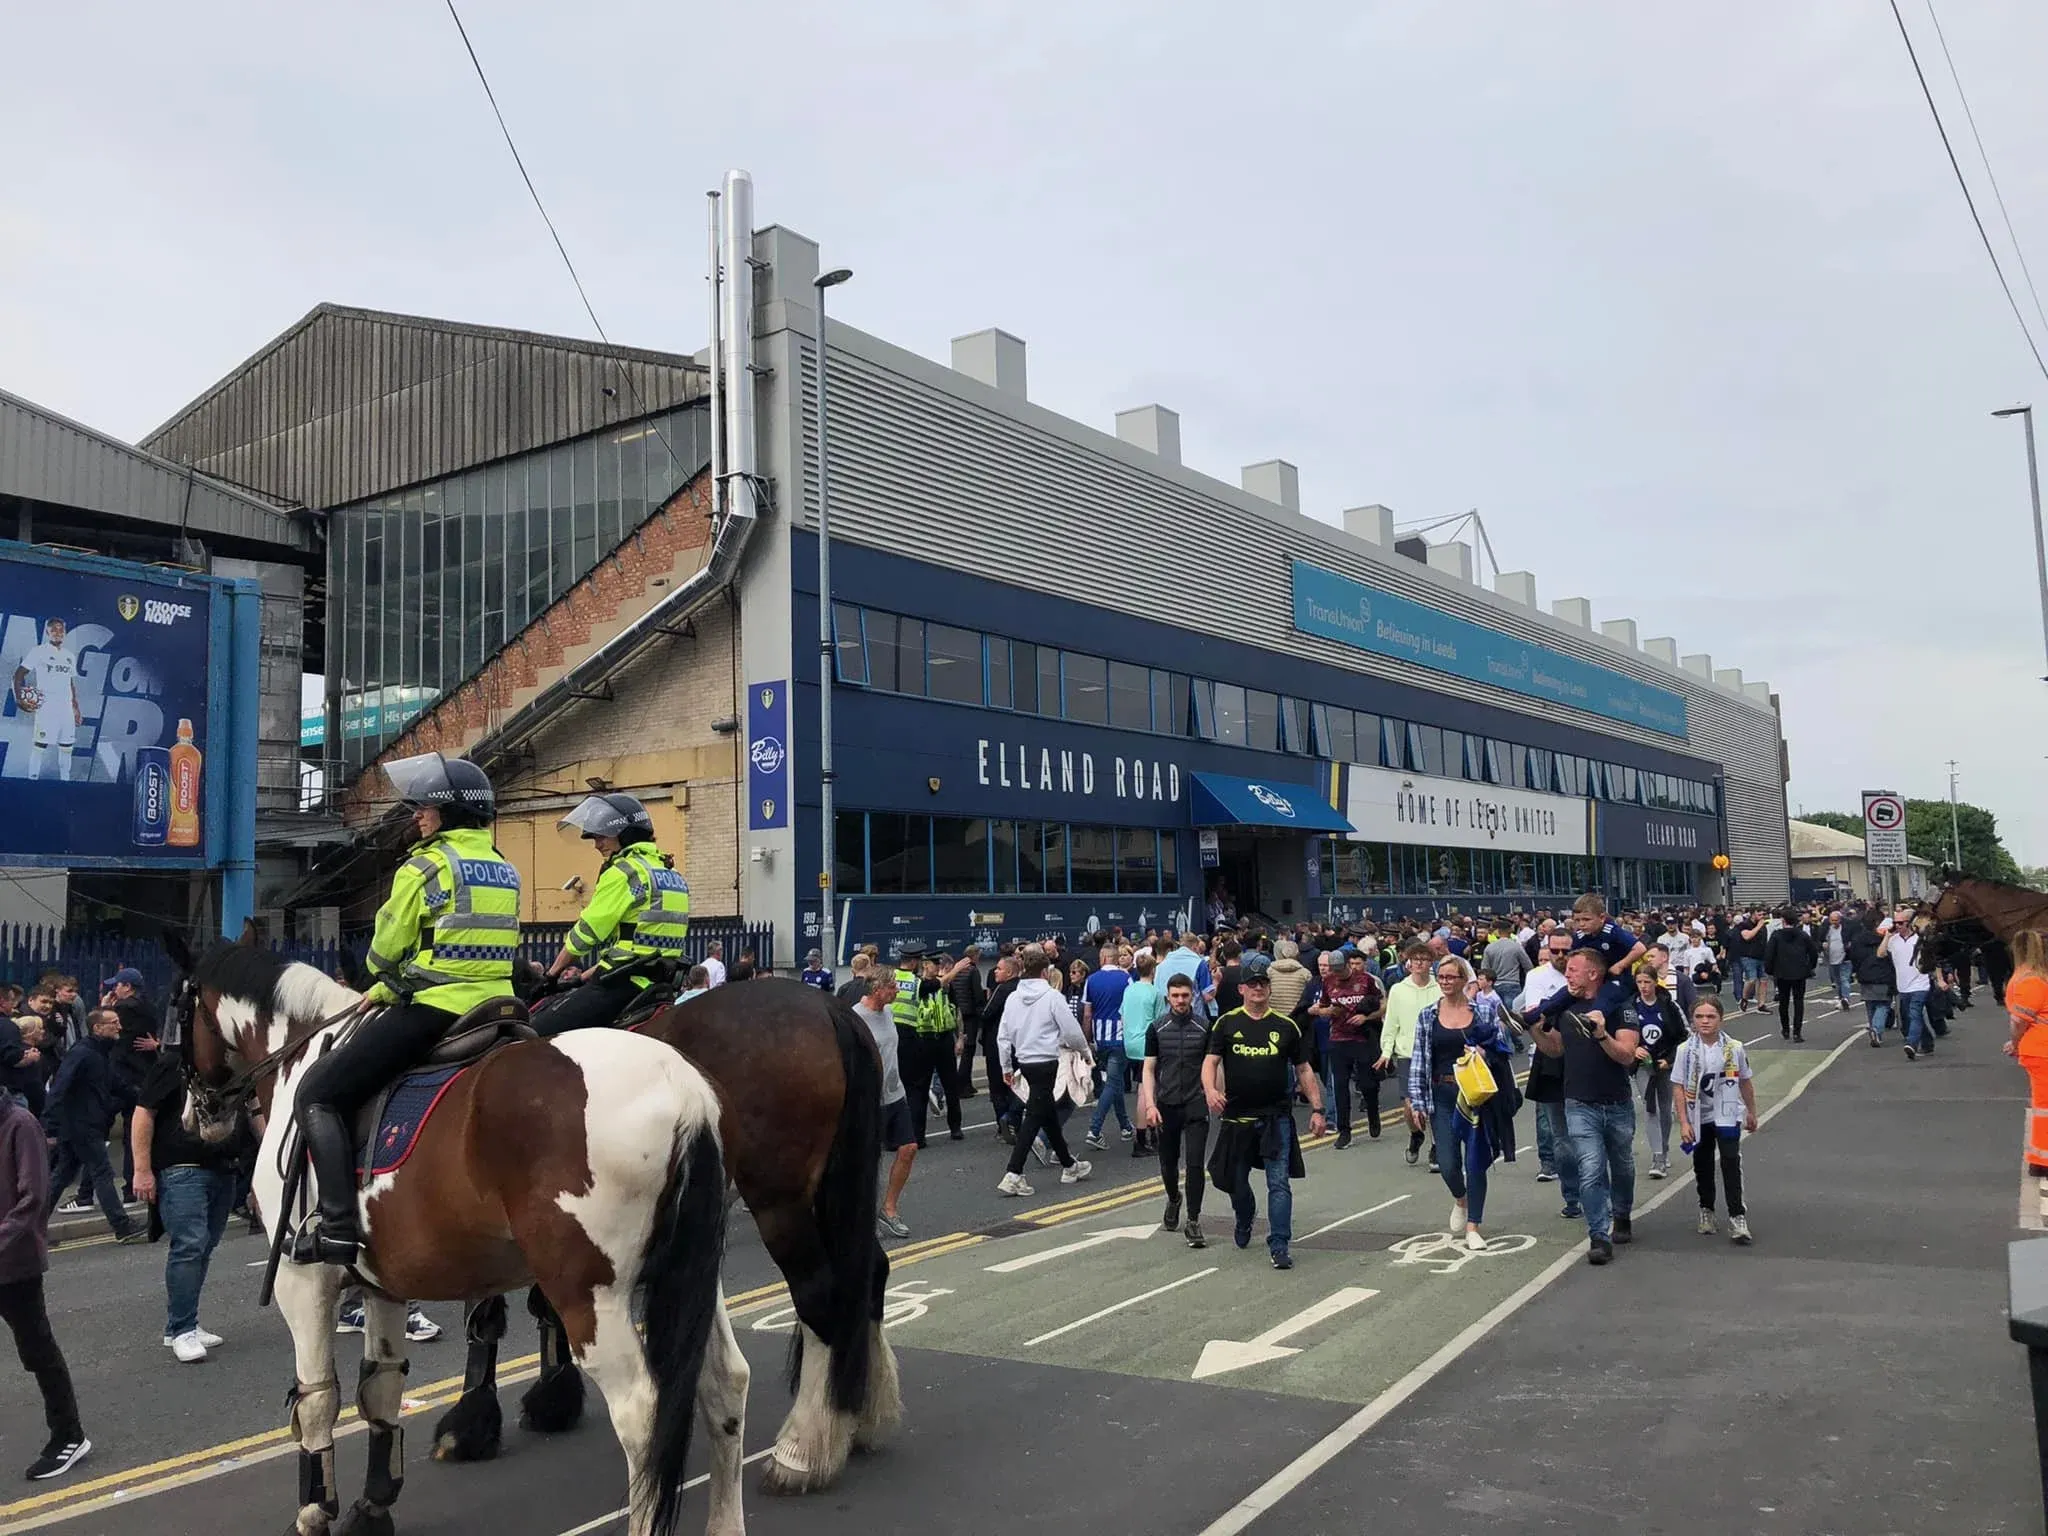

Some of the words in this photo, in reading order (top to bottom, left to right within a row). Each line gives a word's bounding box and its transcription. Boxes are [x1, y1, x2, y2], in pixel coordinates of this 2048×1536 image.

[144, 611, 174, 626] NOW
[145, 600, 191, 618] CHOOSE
[1306, 598, 1365, 634] TransUnion
[1376, 619, 1420, 655] Believing
[1421, 633, 1431, 651] in
[1432, 638, 1457, 660] Leeds
[180, 762, 189, 808] BOOST
[978, 740, 1094, 795] ELLAND
[1115, 757, 1180, 802] ROAD
[147, 767, 159, 820] BOOST
[1397, 791, 1436, 825] HOME
[1446, 798, 1460, 827] OF
[1469, 799, 1507, 832] LEEDS
[1514, 806, 1555, 836] UNITED
[462, 863, 517, 886] POLICE
[1232, 1043, 1269, 1057] Clipper
[1645, 1029, 1661, 1040] JD
